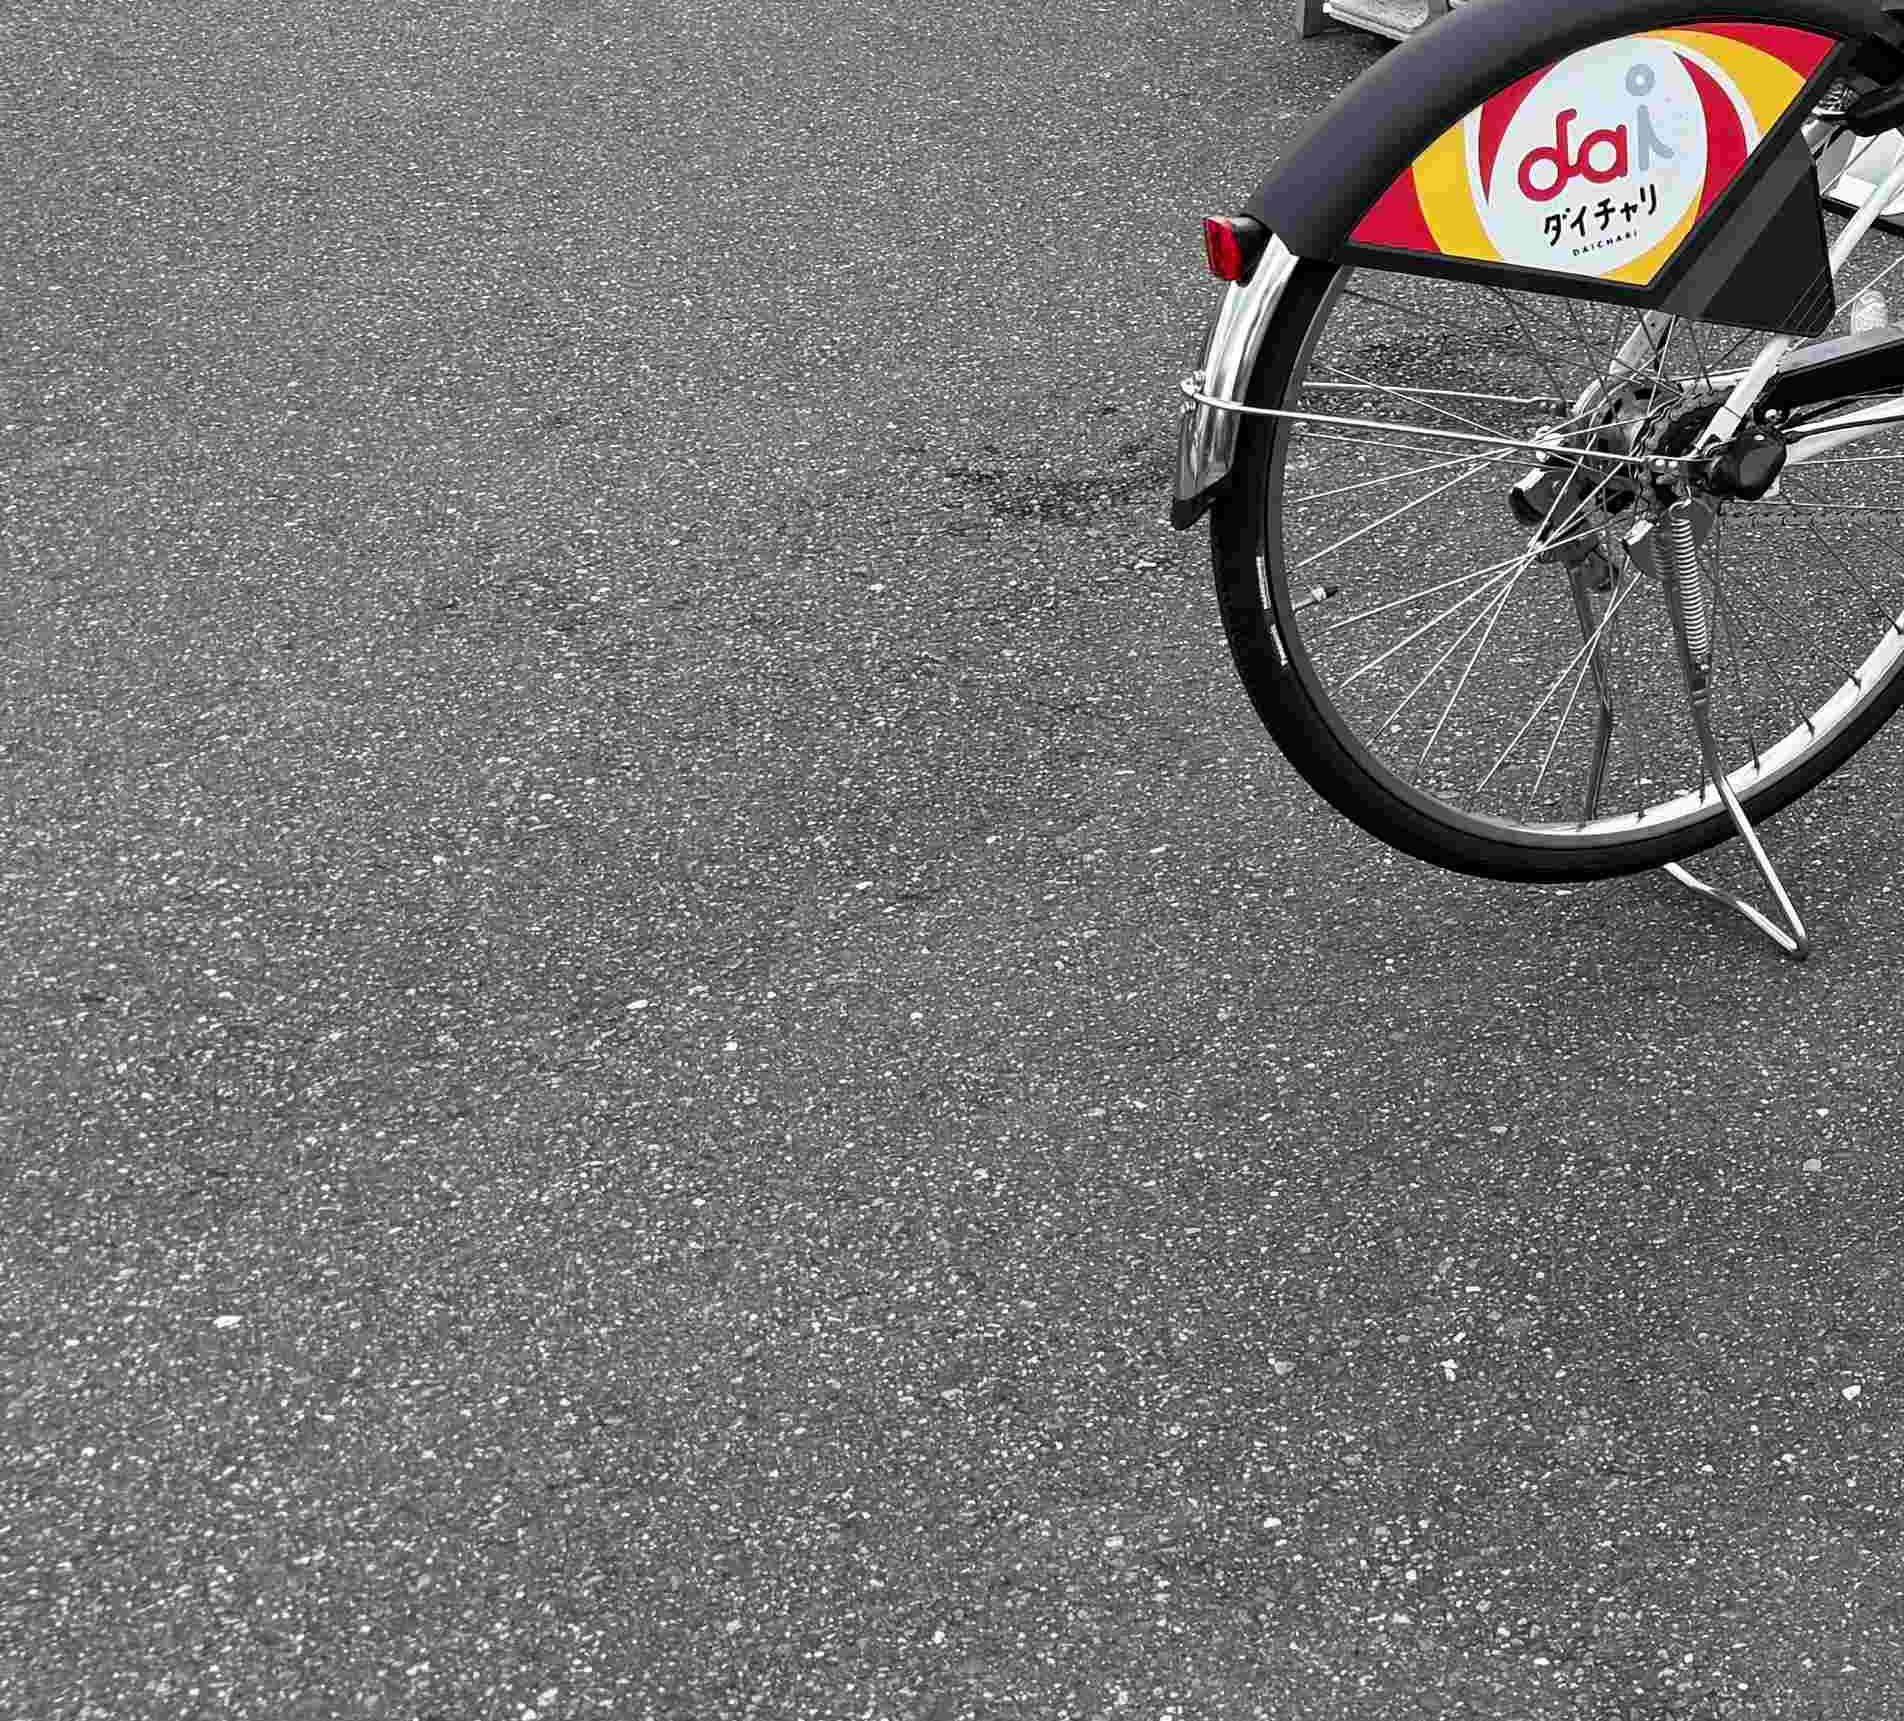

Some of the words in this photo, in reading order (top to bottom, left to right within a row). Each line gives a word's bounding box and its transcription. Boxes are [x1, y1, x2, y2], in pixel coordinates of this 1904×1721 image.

[1518, 64, 1675, 202] dai
[1544, 184, 1657, 247] ダイチャリ
[1571, 230, 1639, 257] DAICHARI
